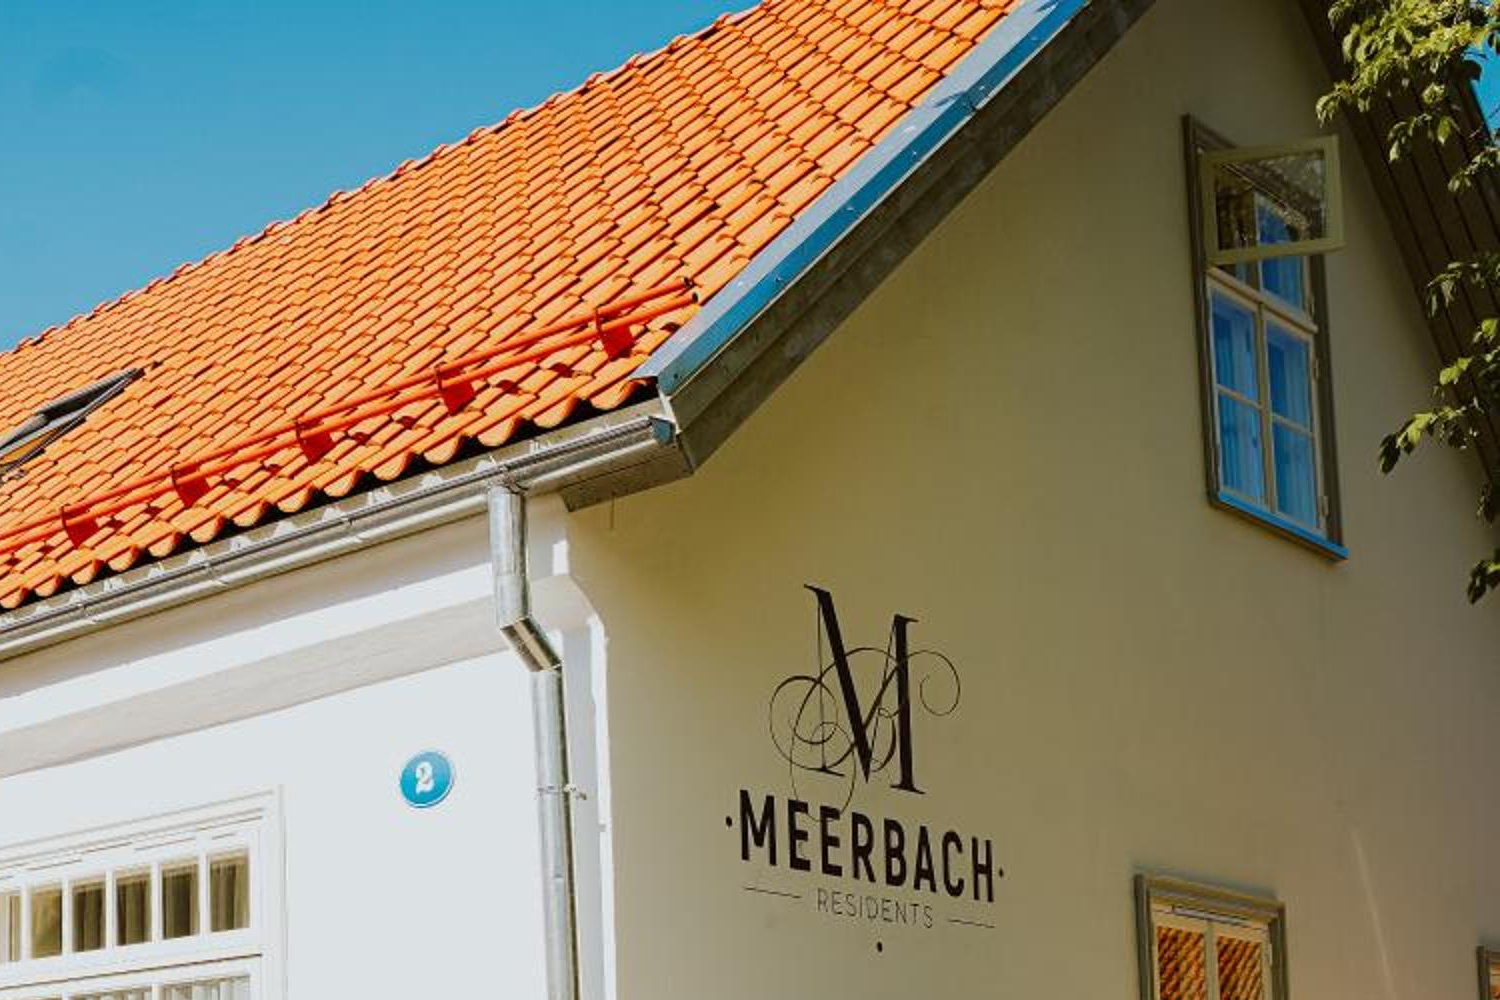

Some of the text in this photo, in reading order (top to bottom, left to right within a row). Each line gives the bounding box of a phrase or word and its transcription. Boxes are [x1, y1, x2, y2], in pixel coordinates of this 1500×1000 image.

[415, 761, 436, 795] 2
[739, 789, 995, 902] MEERBACH
[817, 887, 933, 929] RESIDENTS
